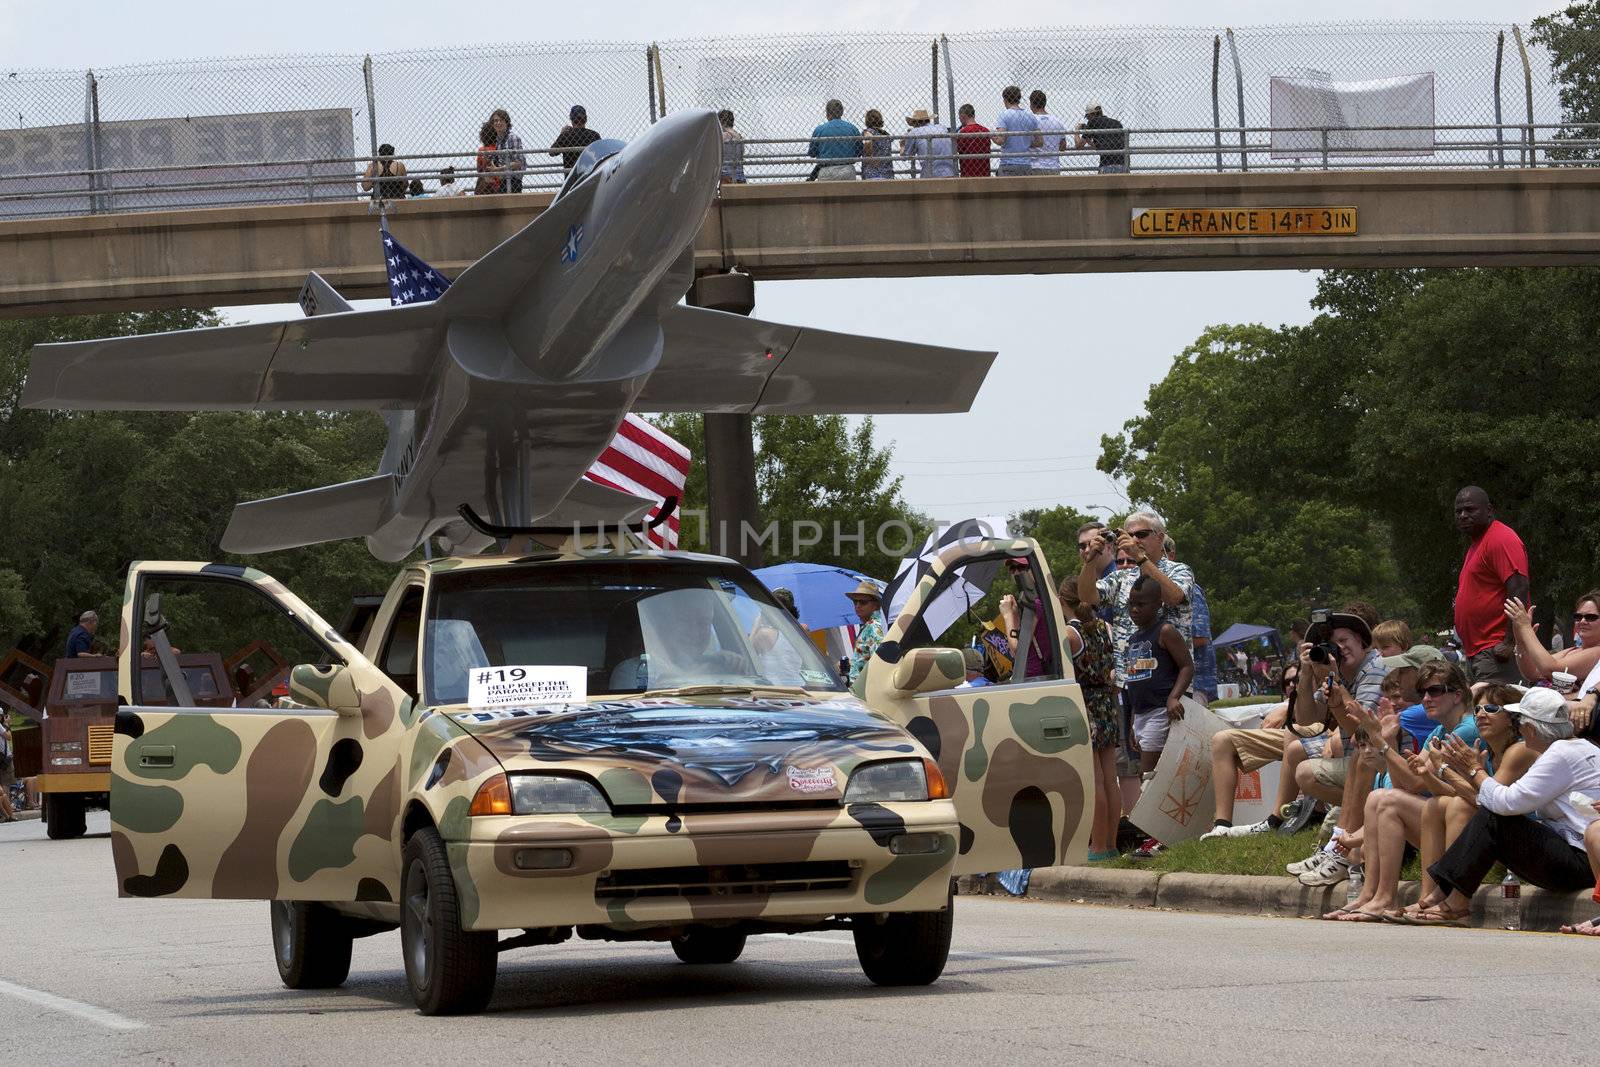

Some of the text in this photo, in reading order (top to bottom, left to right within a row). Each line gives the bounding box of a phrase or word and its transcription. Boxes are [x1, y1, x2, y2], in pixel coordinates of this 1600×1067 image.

[1140, 212, 1259, 232] CLEARANCE
[1321, 211, 1351, 230] 3IN
[394, 436, 414, 496] NAVY
[477, 668, 527, 684] #19
[488, 683, 515, 691] HELP
[488, 687, 534, 695] PARADE
